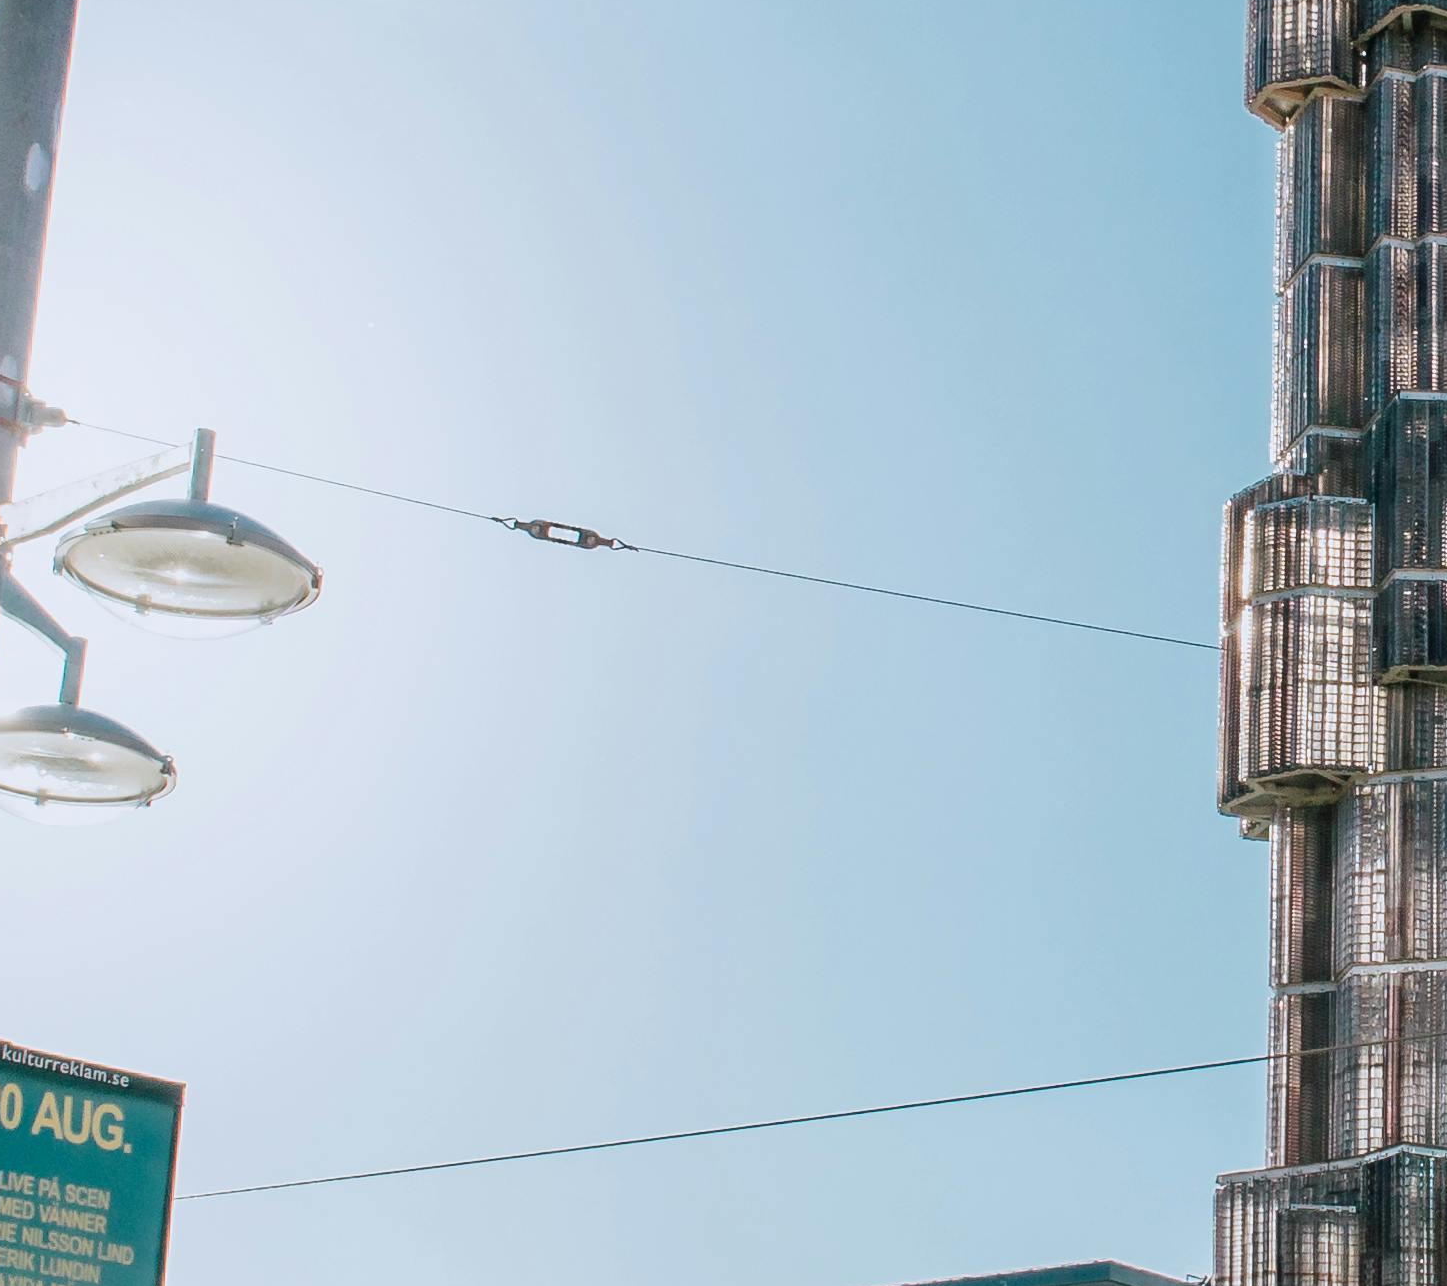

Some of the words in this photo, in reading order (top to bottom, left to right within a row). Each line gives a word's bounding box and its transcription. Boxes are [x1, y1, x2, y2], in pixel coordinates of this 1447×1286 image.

[2, 1044, 129, 1087] kulturreklam.se
[31, 1091, 131, 1153] AUG.
[39, 1177, 61, 1201] PÅ
[65, 1184, 110, 1210] SCEN
[40, 1203, 107, 1233] VÄNNER
[22, 1226, 94, 1257] NILSSON
[98, 1241, 134, 1265] LIND
[40, 1256, 100, 1284] LUNDIN
